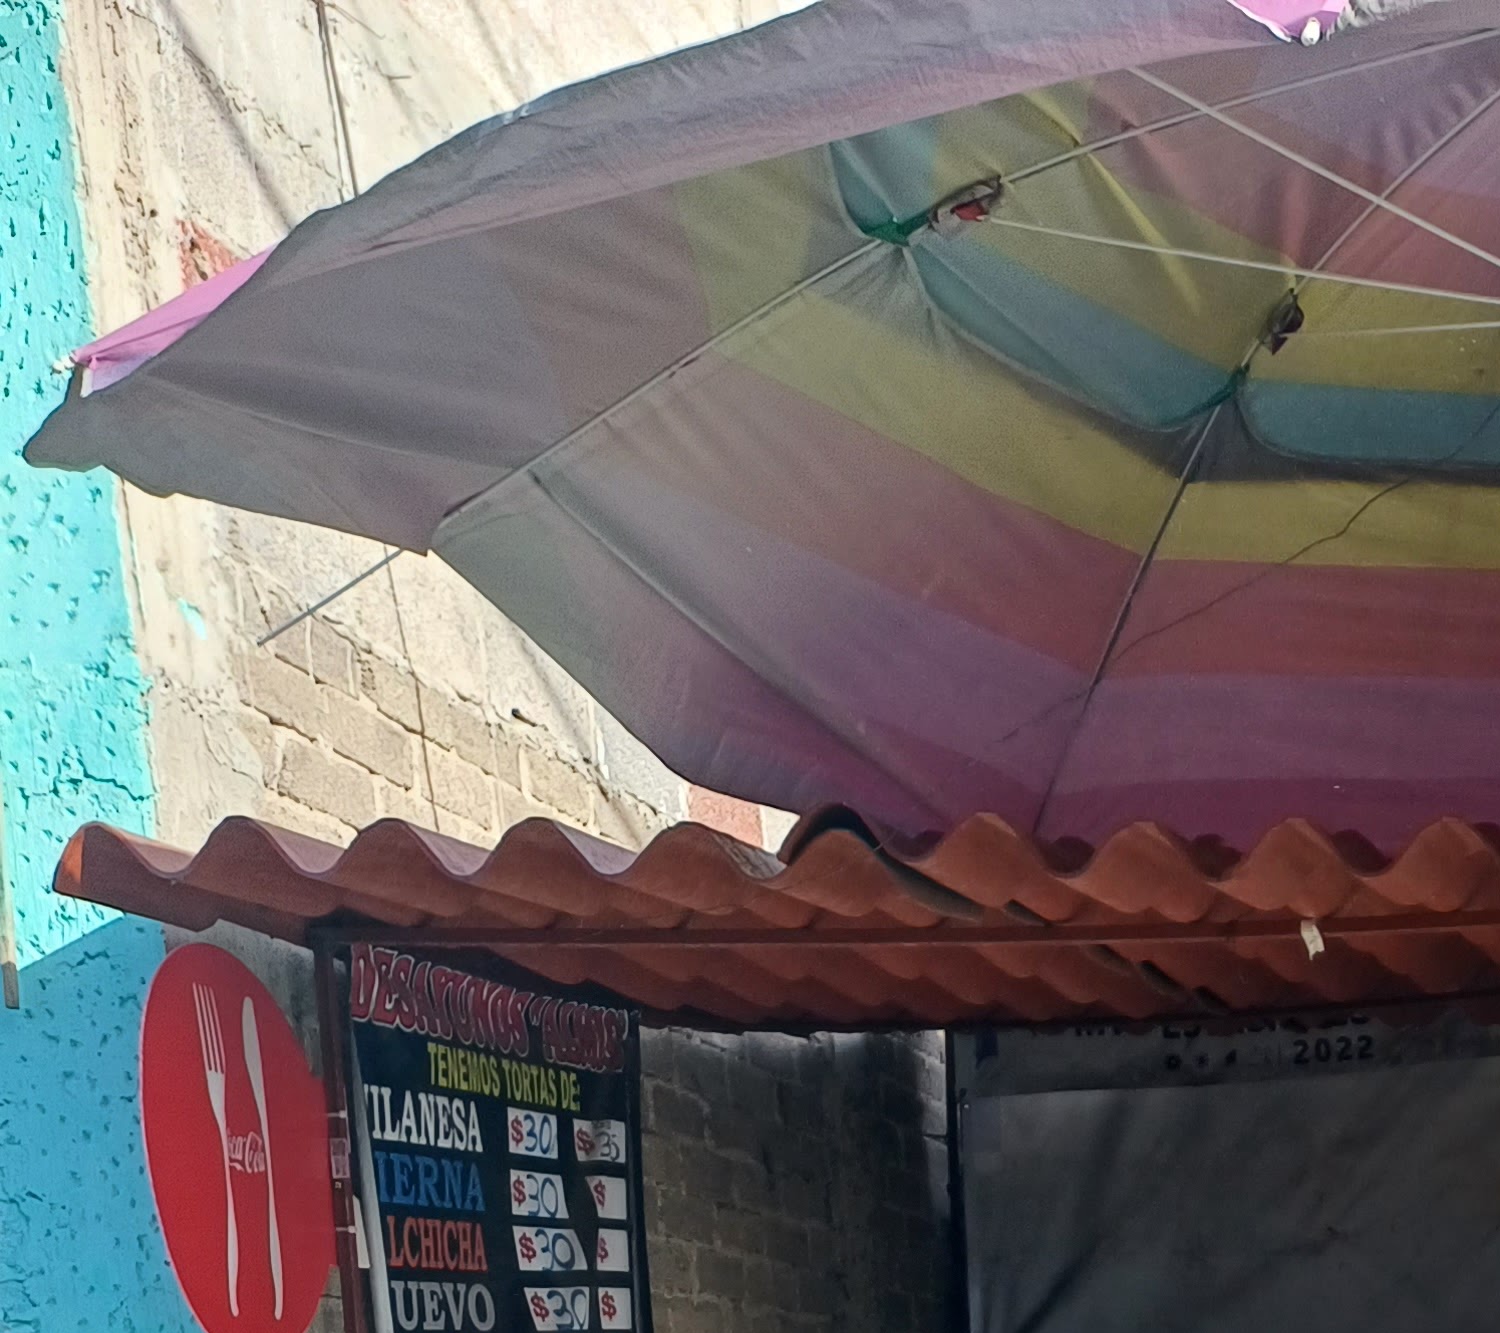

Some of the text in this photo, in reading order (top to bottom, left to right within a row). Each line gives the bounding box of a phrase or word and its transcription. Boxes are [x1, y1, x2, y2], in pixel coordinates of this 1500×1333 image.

[427, 1042, 500, 1097] TENEMOS
[501, 1057, 558, 1107] TORTAS
[1292, 1034, 1376, 1065] 2022
[364, 1084, 484, 1153] ILANESA
